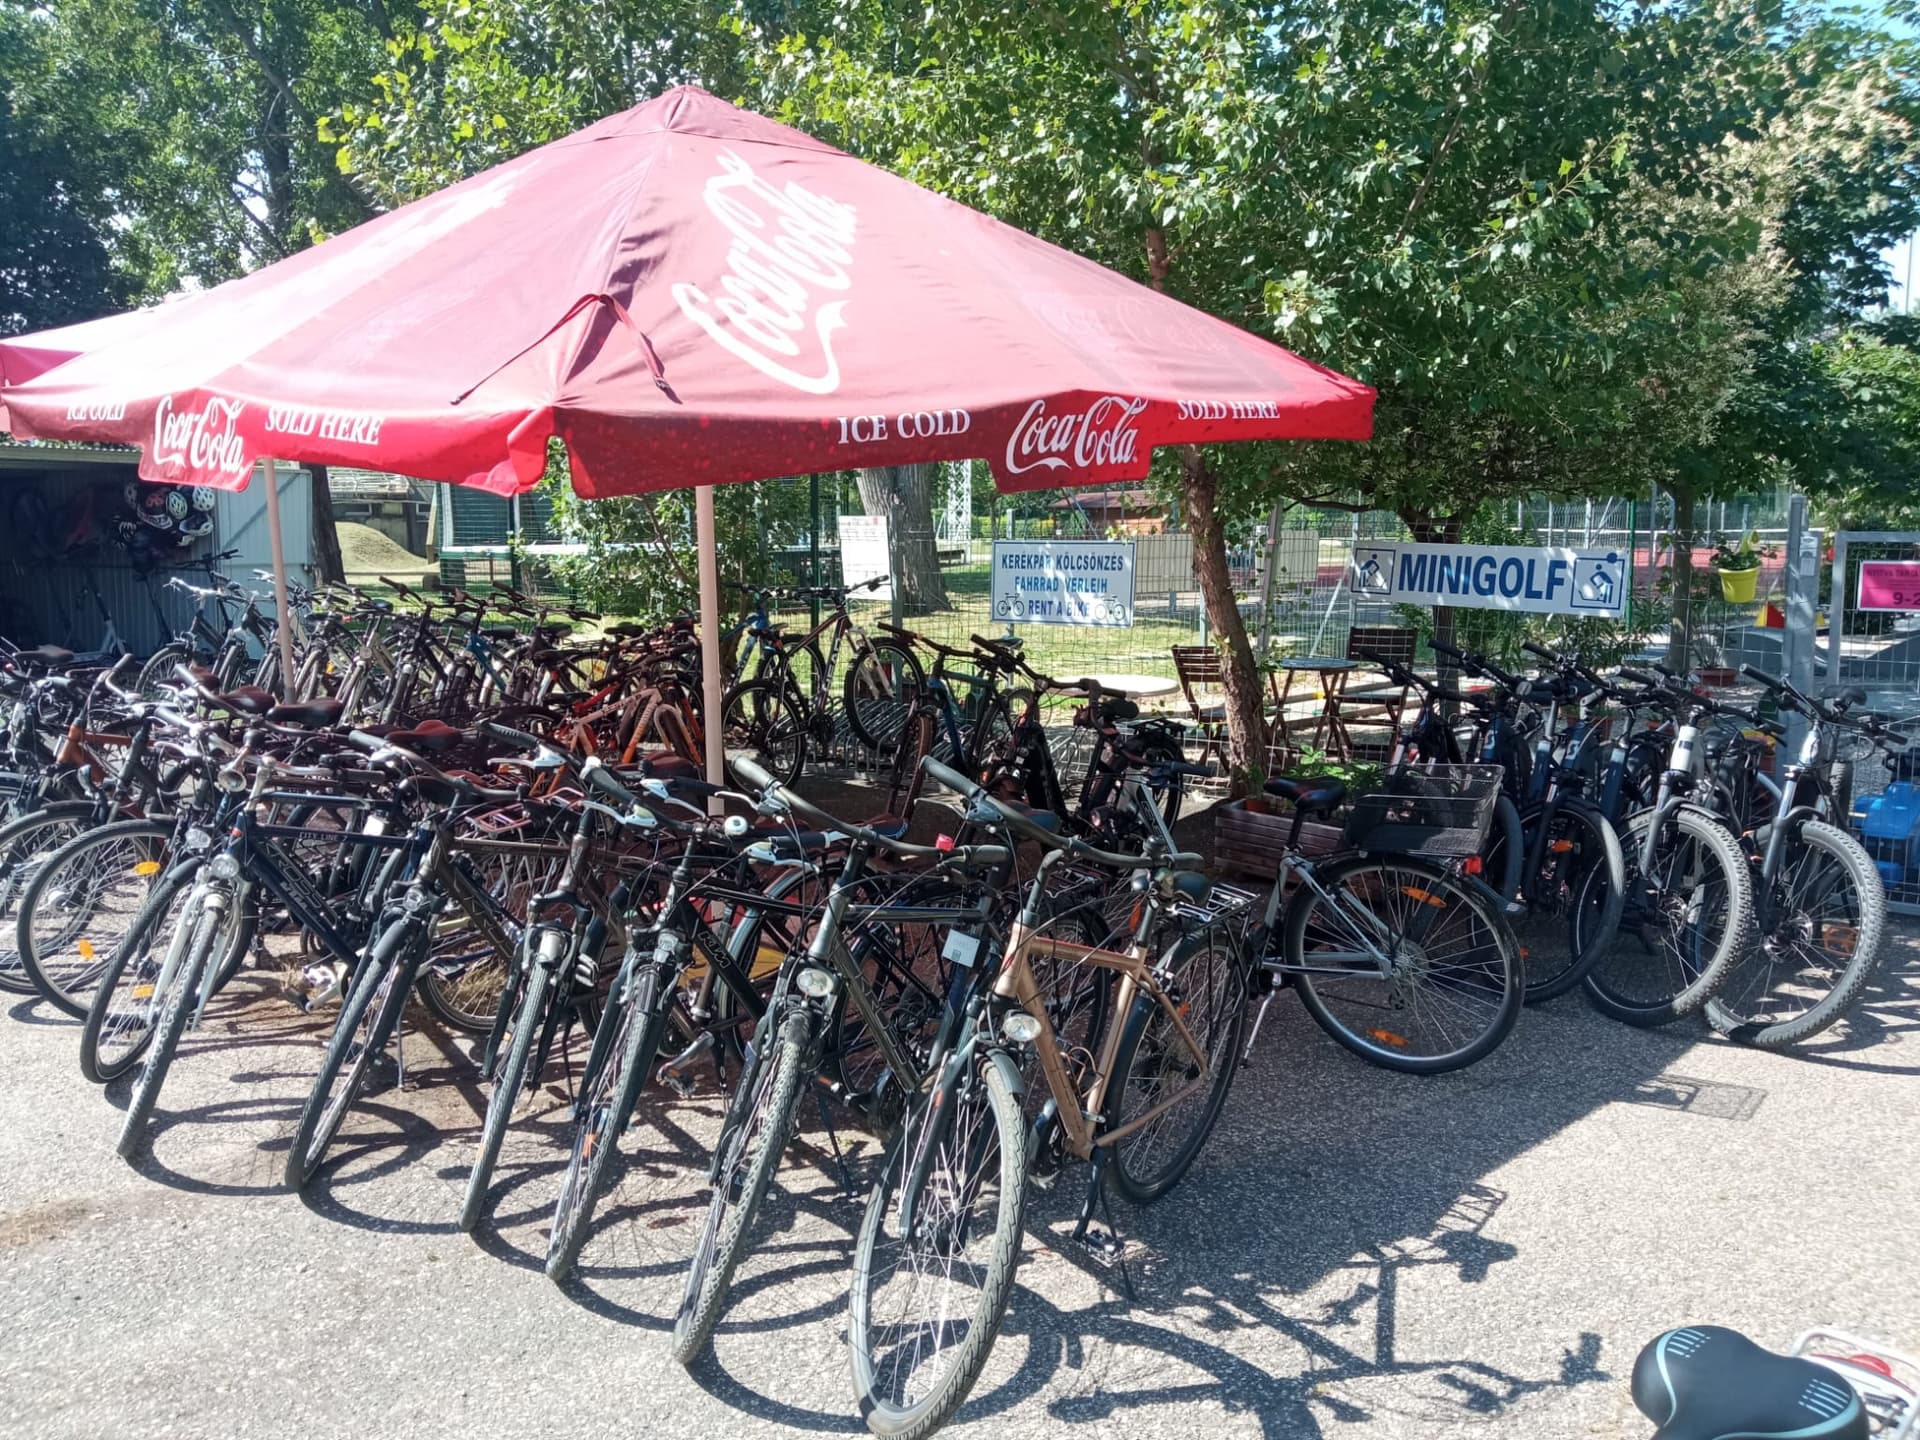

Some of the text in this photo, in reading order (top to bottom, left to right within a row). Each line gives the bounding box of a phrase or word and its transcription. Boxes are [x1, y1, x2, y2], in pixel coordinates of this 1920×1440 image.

[89, 403, 126, 420] COLD
[265, 405, 384, 446] SOLD HERE
[837, 408, 971, 445] ICE COLD
[1177, 399, 1281, 420] SOLD HERE
[153, 396, 247, 474] Coca-Cola
[1006, 396, 1149, 474] Coca-Cola
[1014, 576, 1107, 593] FAHRRAD VERLEIH
[1398, 553, 1567, 600] MINIGOLF
[1028, 599, 1054, 616] RENT
[1056, 601, 1063, 616] A
[464, 893, 514, 959] KROS
